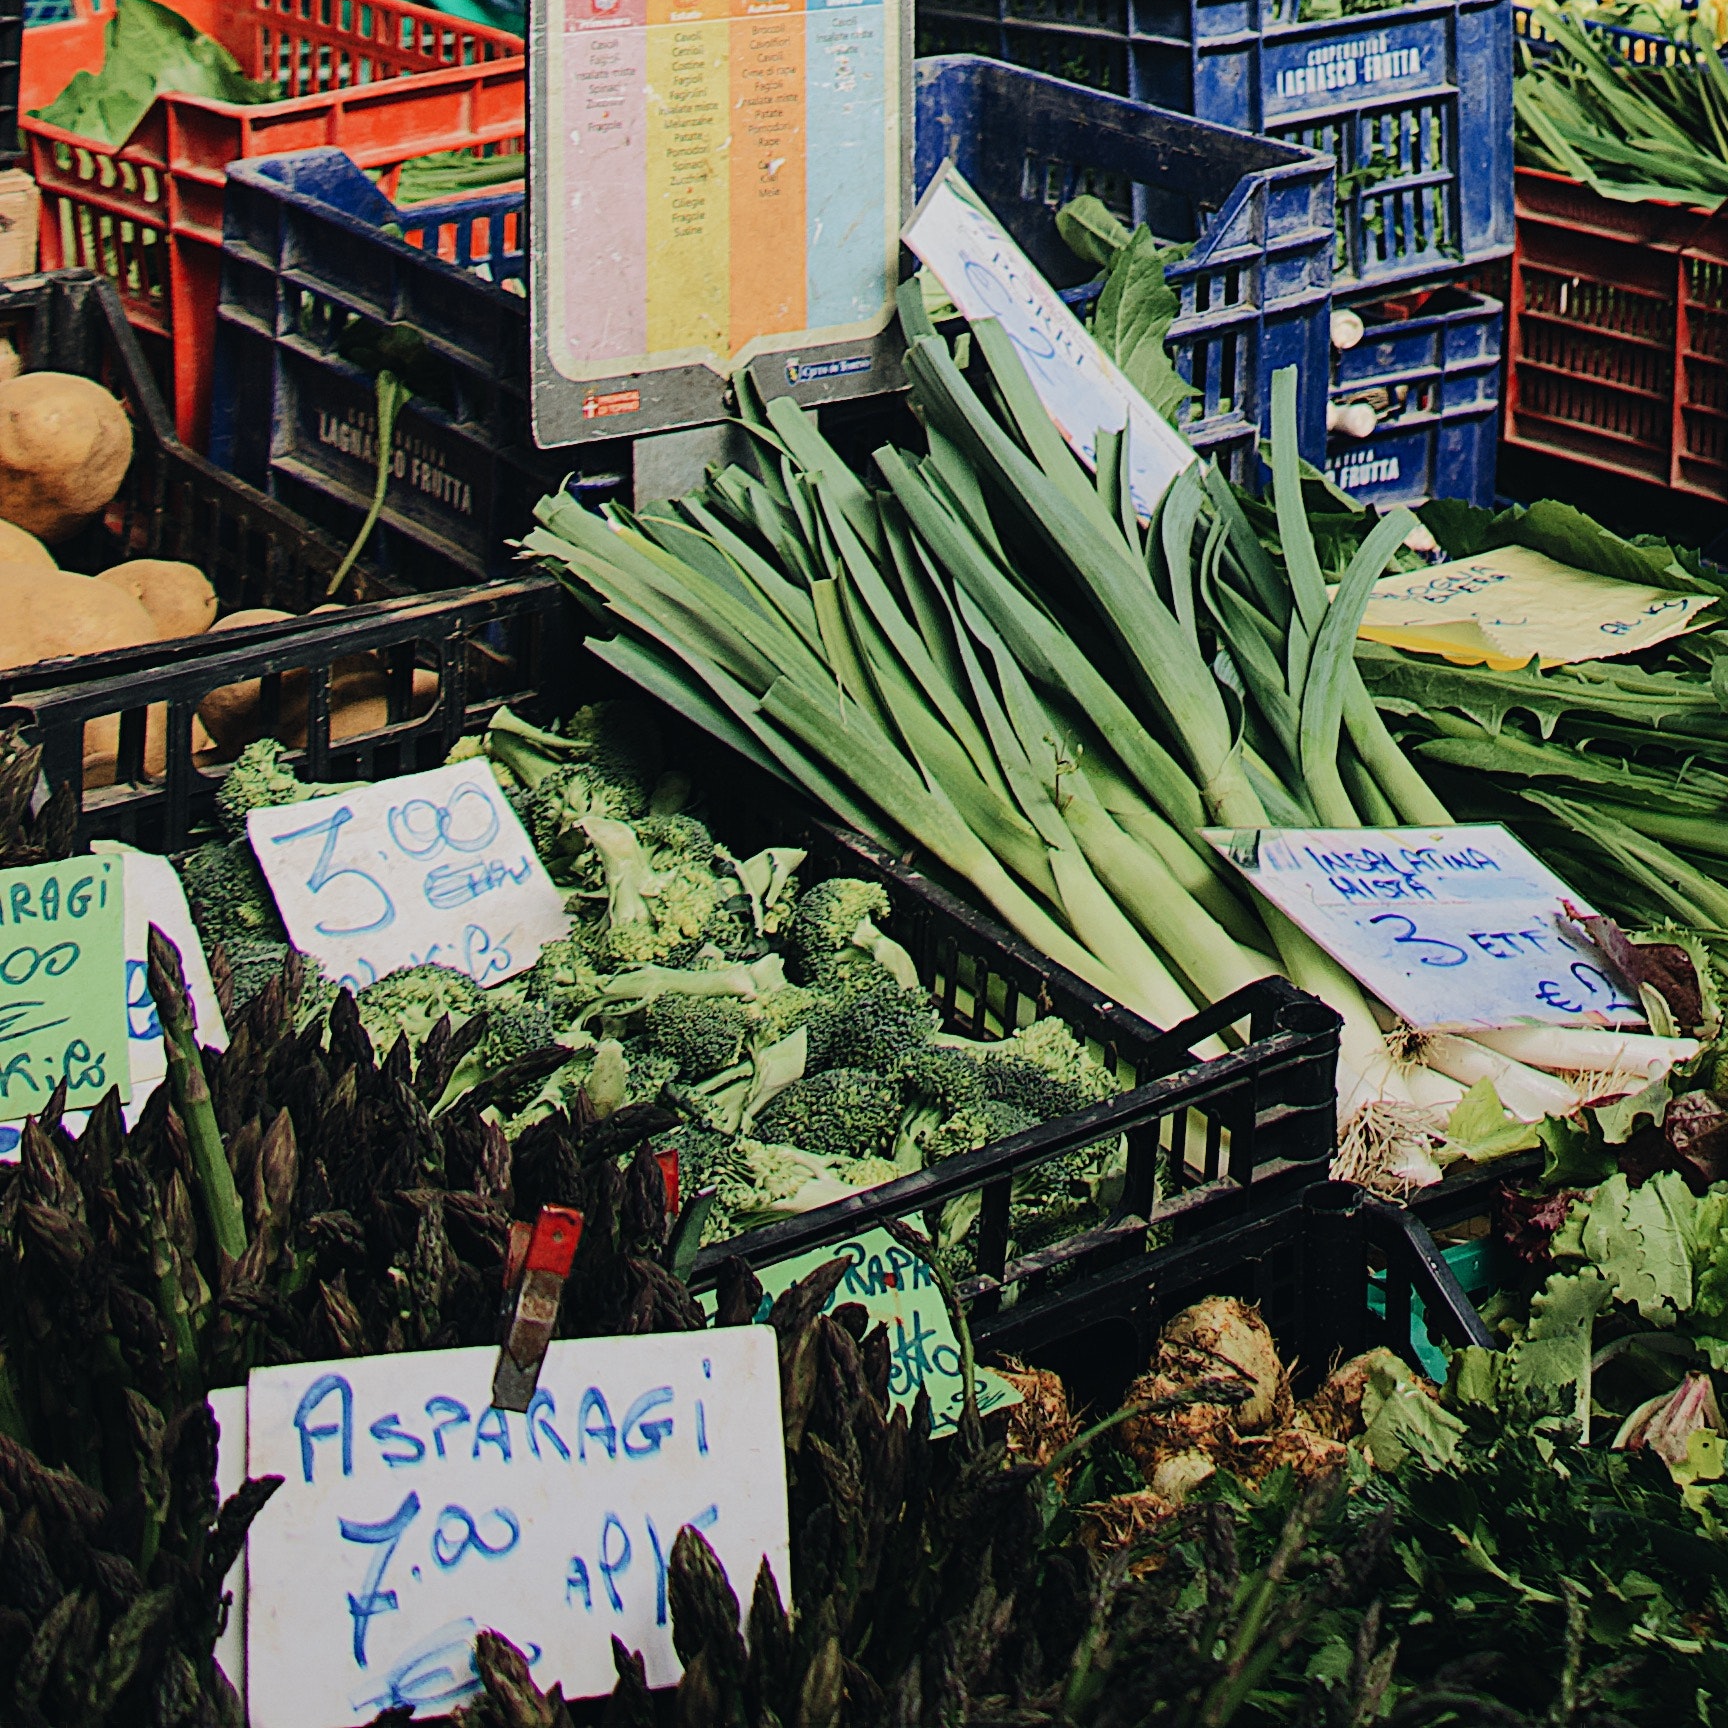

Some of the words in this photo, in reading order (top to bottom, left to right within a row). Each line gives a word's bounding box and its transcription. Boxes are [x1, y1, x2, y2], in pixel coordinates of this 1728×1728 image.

[674, 31, 703, 43] Cavoli
[1276, 58, 1357, 98] LAGNASCO
[1364, 47, 1421, 82] FRUTTA
[672, 211, 706, 224] Fragole
[674, 226, 703, 238] Susine
[992, 252, 1084, 367] PORRI
[411, 457, 472, 516] FRUTTA
[1340, 456, 1400, 491] FRUTTA
[1305, 847, 1501, 878] INSALATINA
[0, 862, 111, 926] RAGI
[1328, 875, 1438, 901] MISTA
[1369, 913, 1470, 968] 3
[294, 1357, 713, 1485] ASPARAGI
